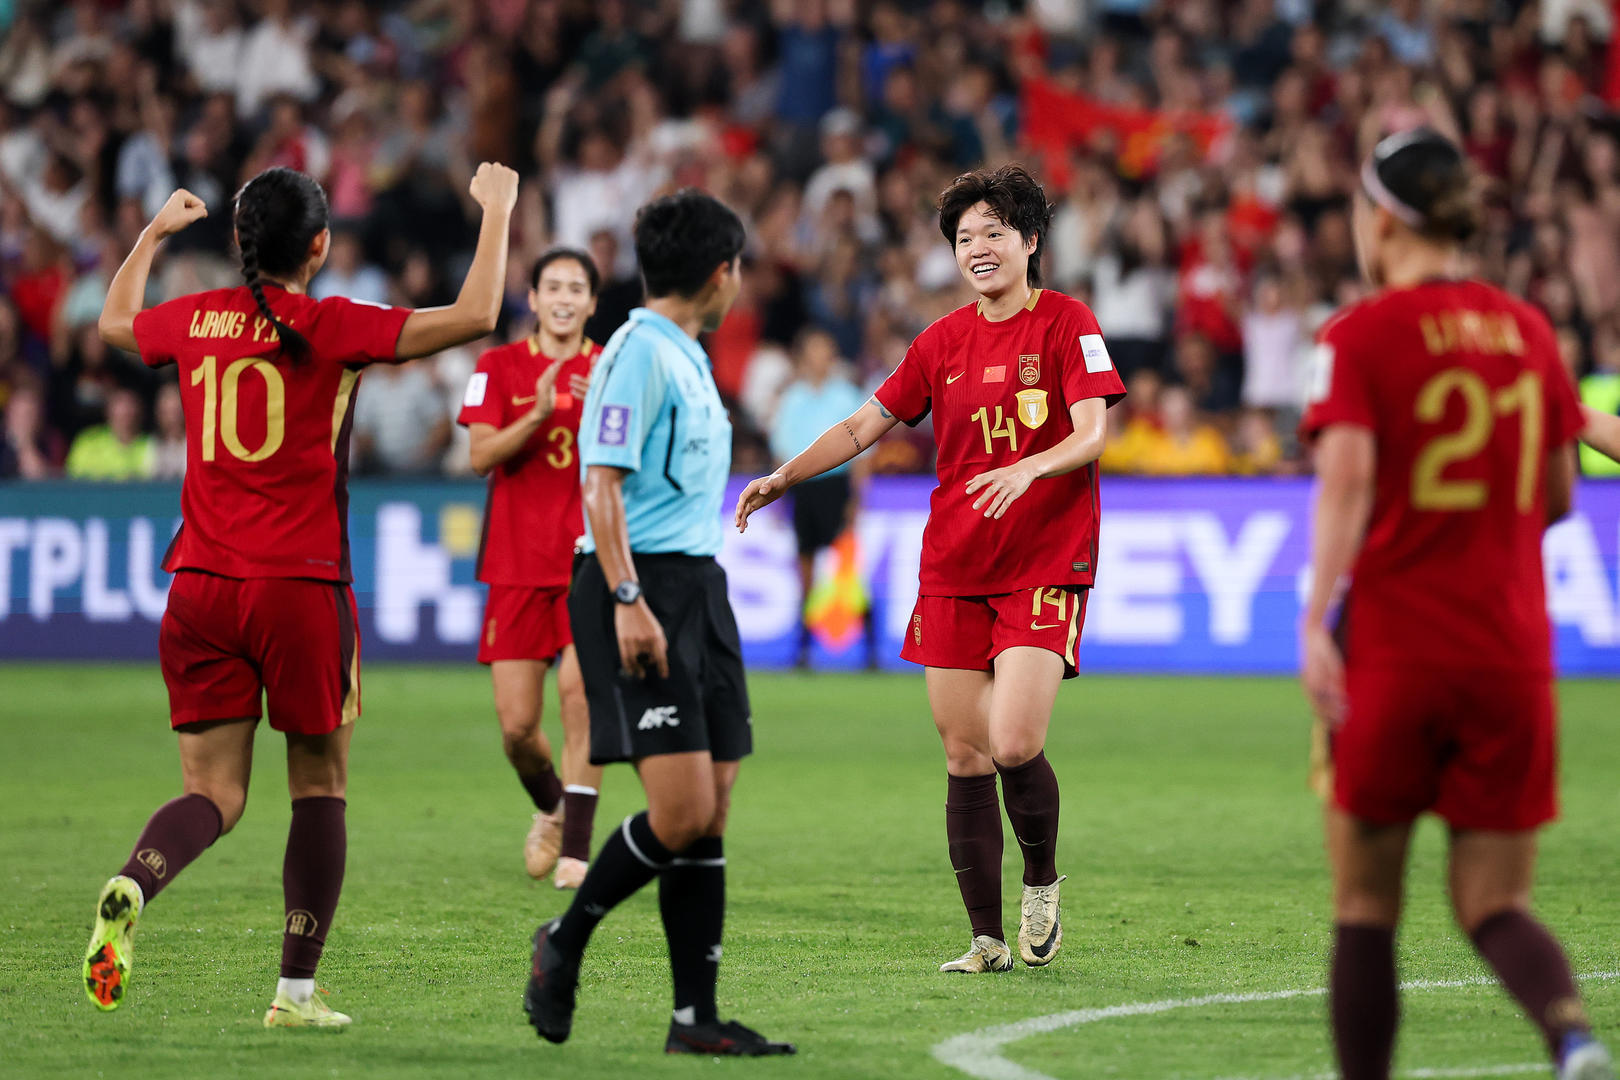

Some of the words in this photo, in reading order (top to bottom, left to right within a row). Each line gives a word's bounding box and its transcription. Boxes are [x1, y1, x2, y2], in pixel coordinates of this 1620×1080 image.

[191, 355, 285, 462] 10
[971, 405, 1017, 454] 14
[547, 426, 573, 469] 3
[1411, 367, 1541, 515] 21
[1028, 587, 1067, 621] 14
[637, 705, 680, 730] AFC
